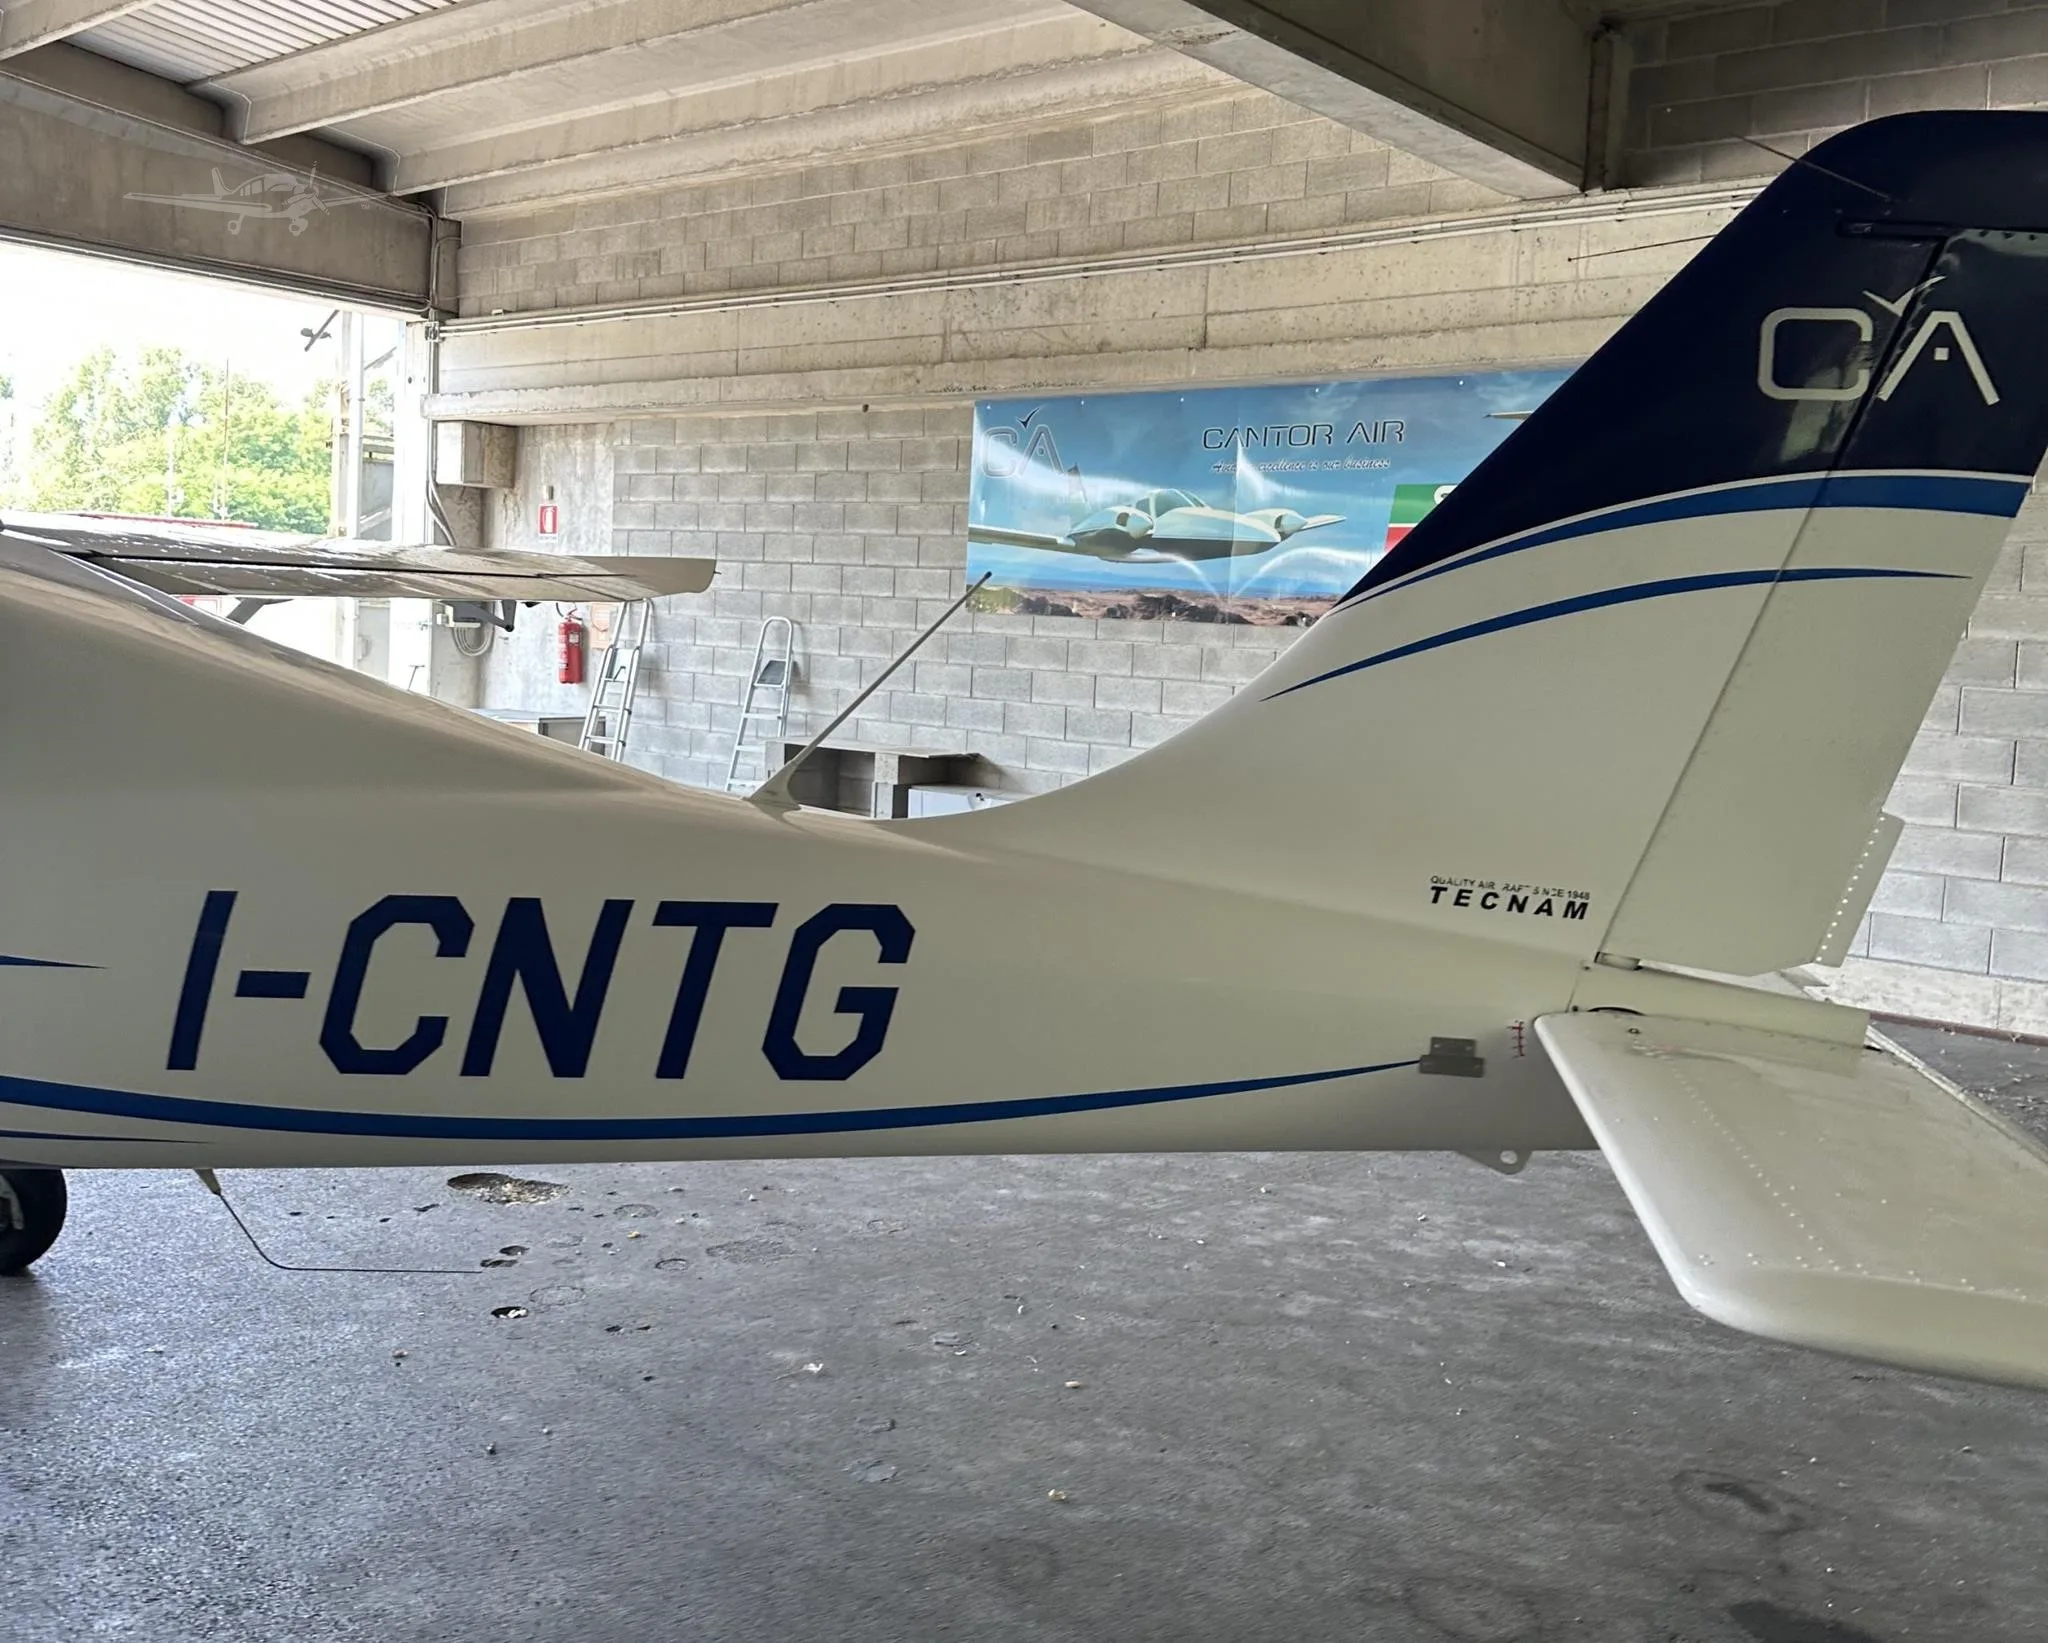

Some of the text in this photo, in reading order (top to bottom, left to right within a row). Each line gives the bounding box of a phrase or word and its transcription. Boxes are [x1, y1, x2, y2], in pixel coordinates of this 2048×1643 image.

[1203, 420, 1405, 449] CANTOR AIR
[1343, 453, 1391, 471] business
[1430, 886, 1589, 920] TECNAM
[1532, 886, 1565, 898] SNCE
[1568, 890, 1591, 901] 1948
[166, 890, 916, 1080] I-CNTG
